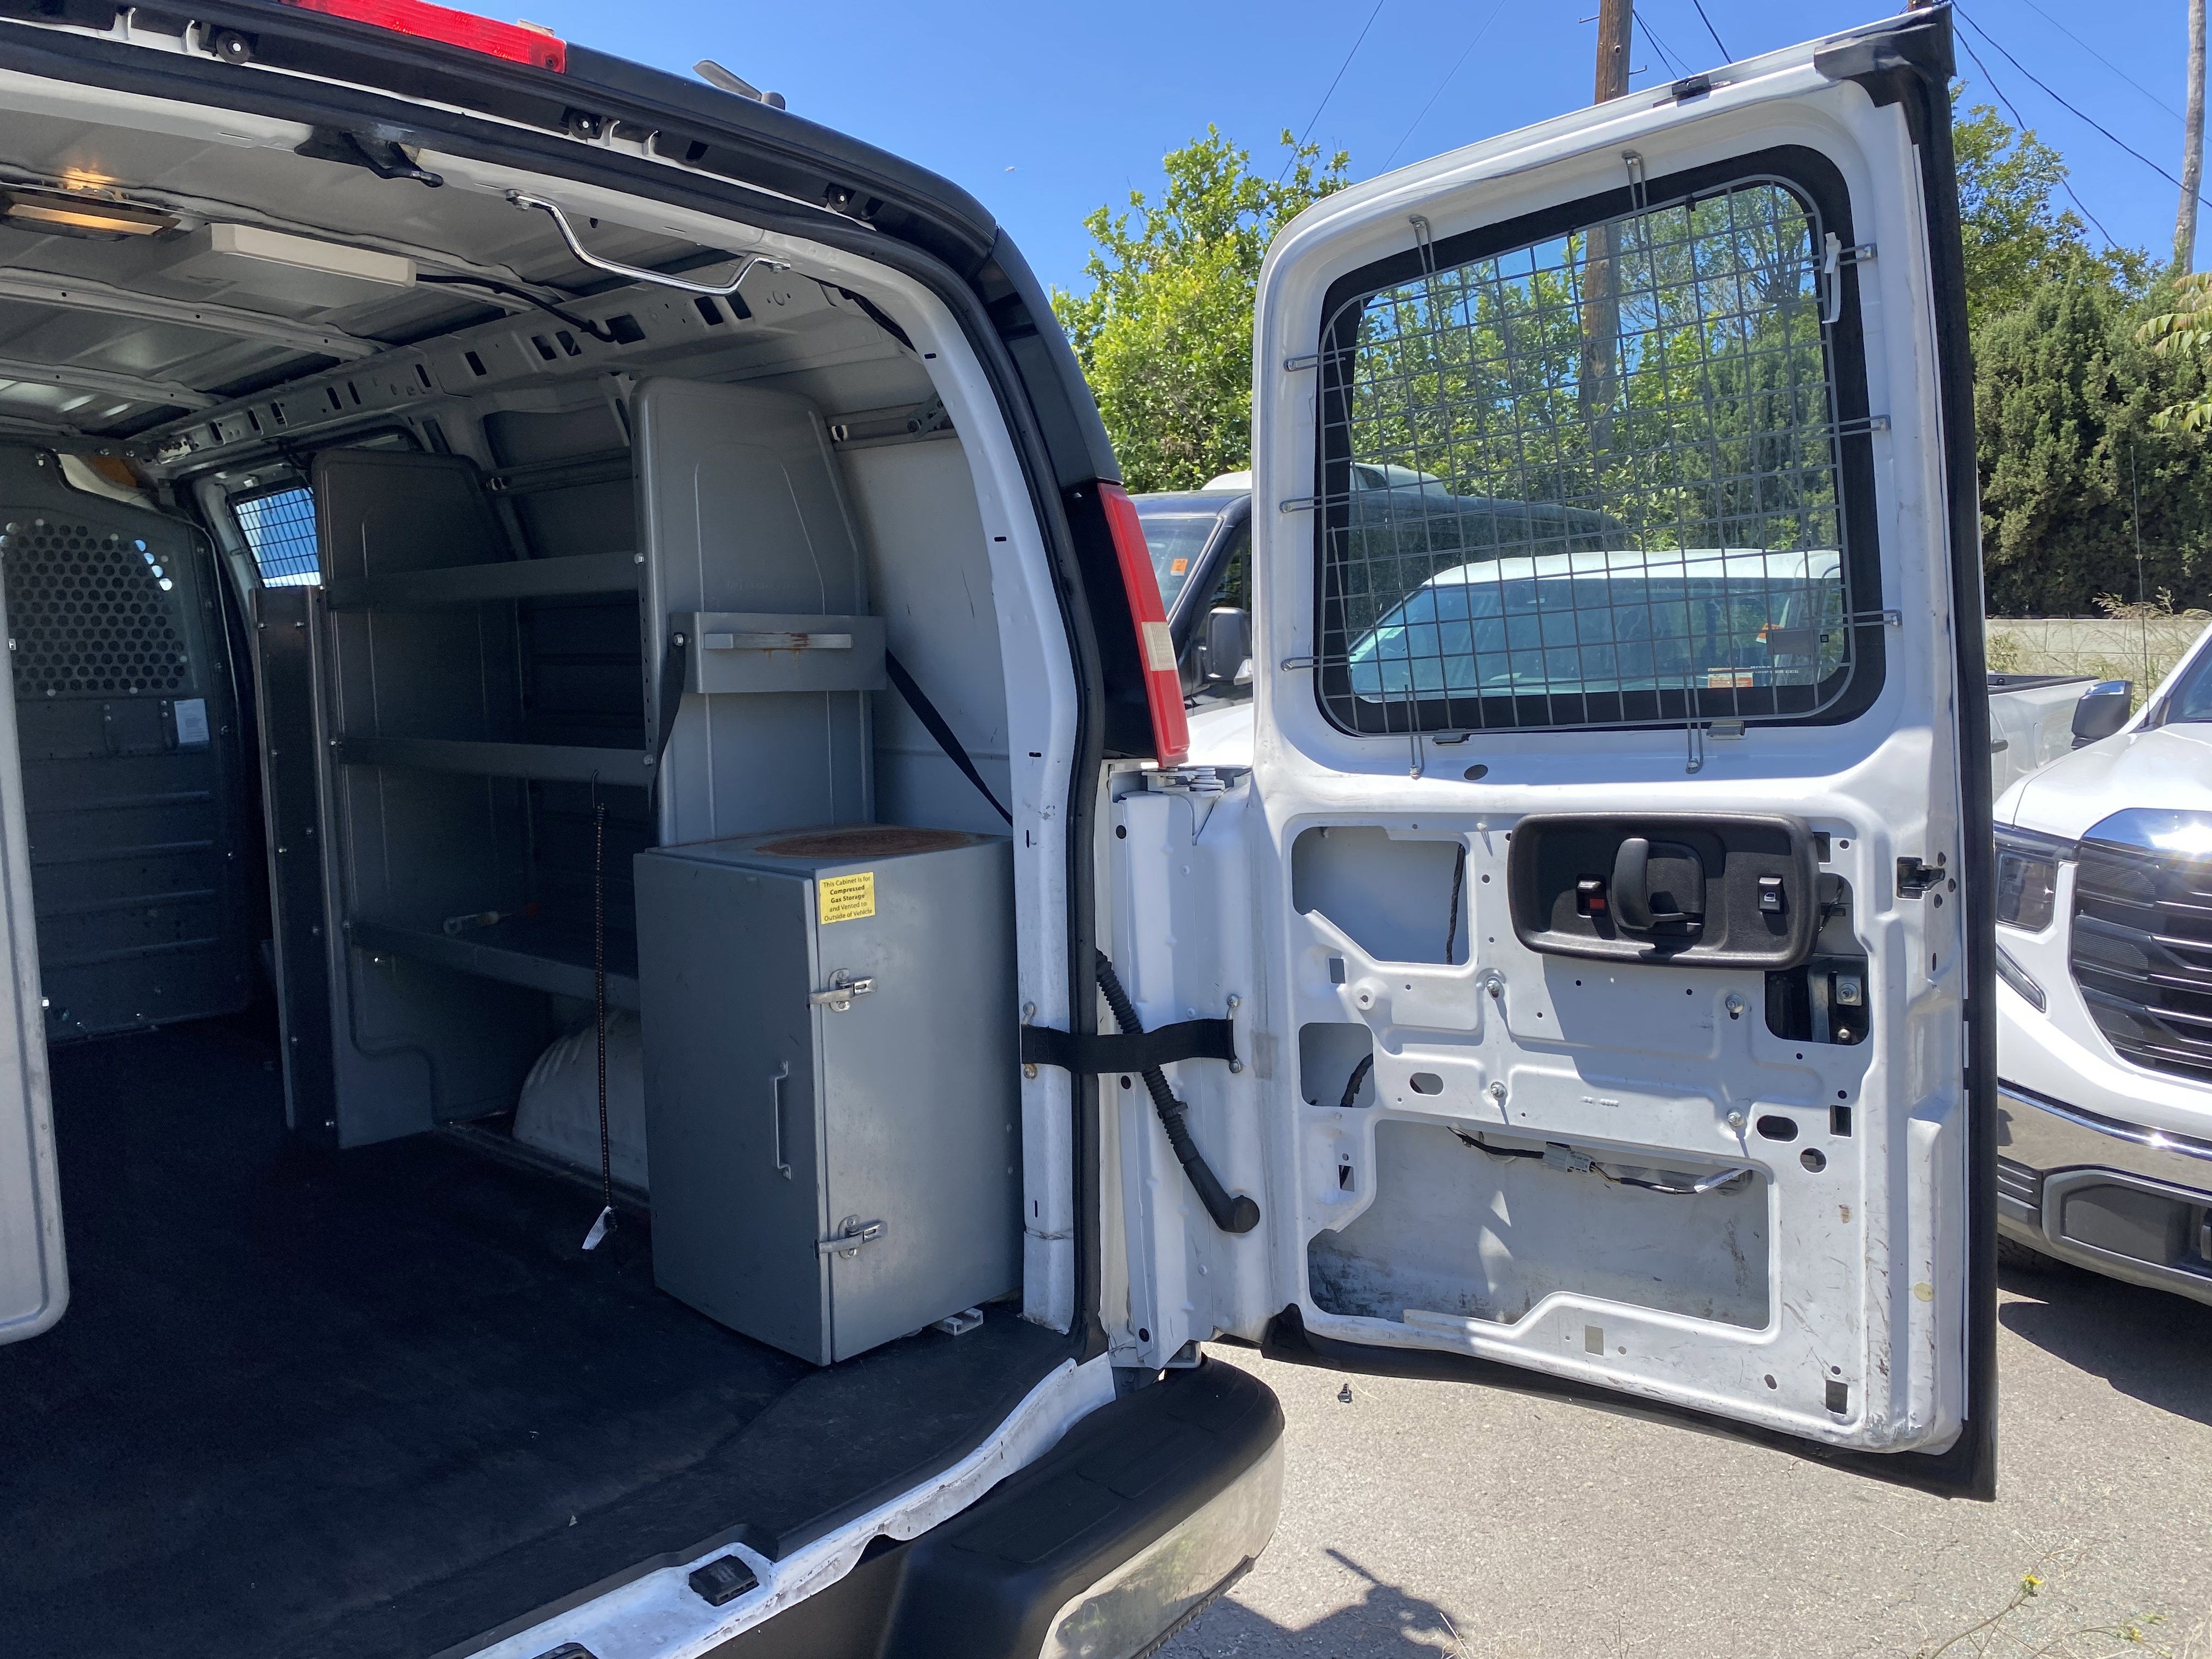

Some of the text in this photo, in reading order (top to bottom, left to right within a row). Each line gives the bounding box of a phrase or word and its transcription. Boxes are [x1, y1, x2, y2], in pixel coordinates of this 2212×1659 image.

[836, 878, 857, 886] Cabinet
[830, 884, 865, 895] Compressed
[841, 902, 860, 910] Vented
[824, 913, 846, 922] Outside
